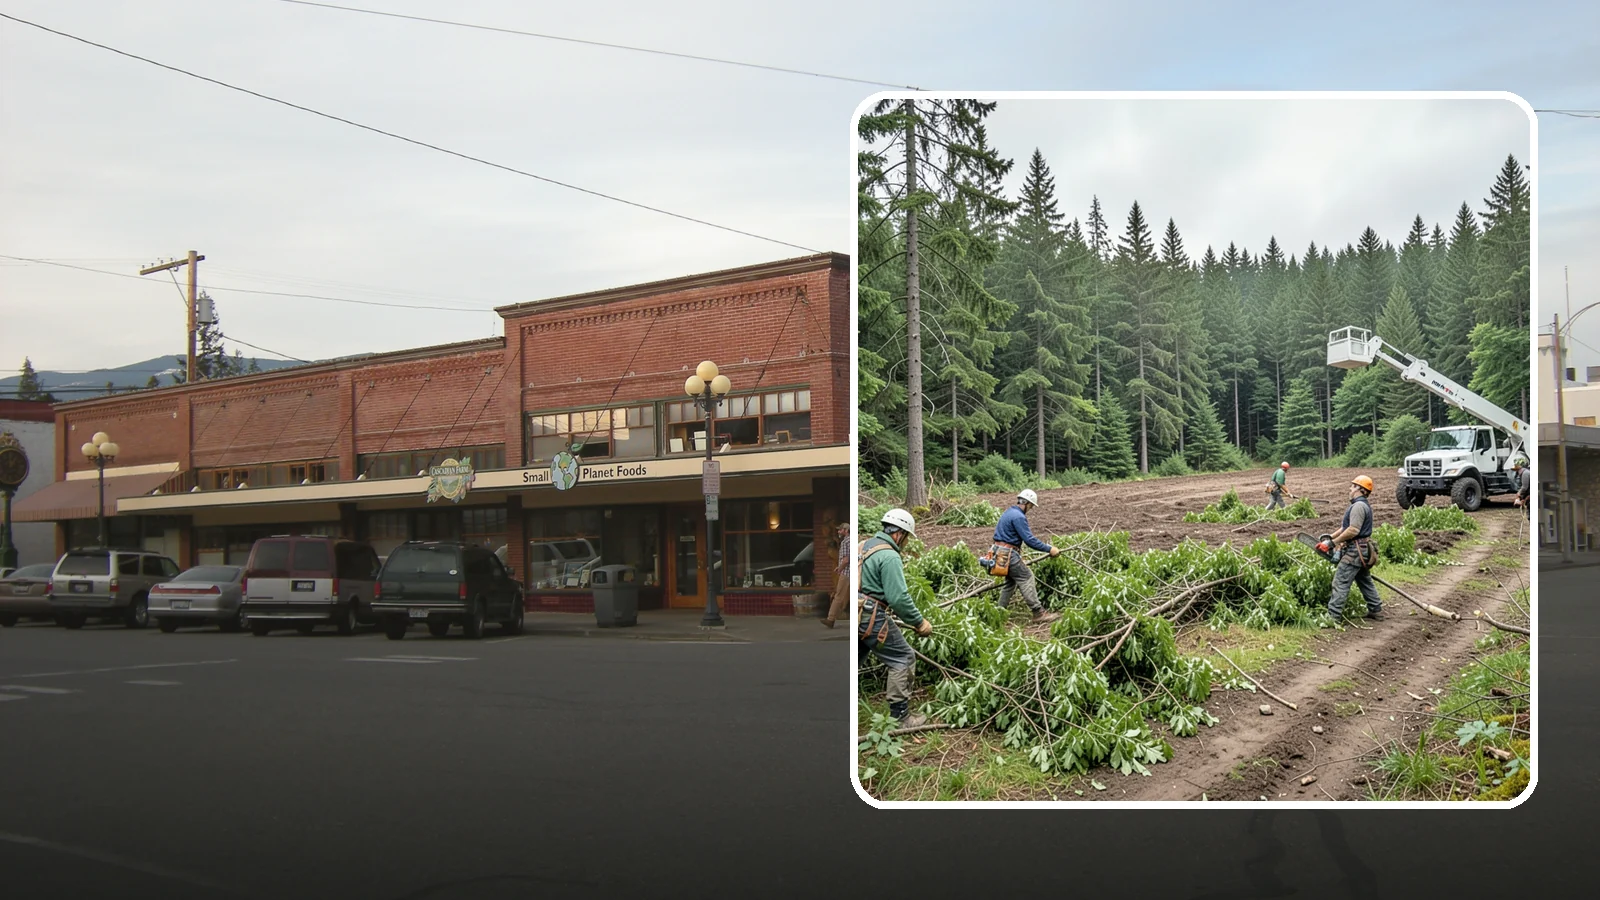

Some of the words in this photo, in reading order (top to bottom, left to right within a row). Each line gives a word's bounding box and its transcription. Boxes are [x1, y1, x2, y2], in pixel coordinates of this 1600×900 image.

[523, 471, 549, 483] Small
[582, 467, 614, 479] Planet
[616, 464, 647, 477] Foods
